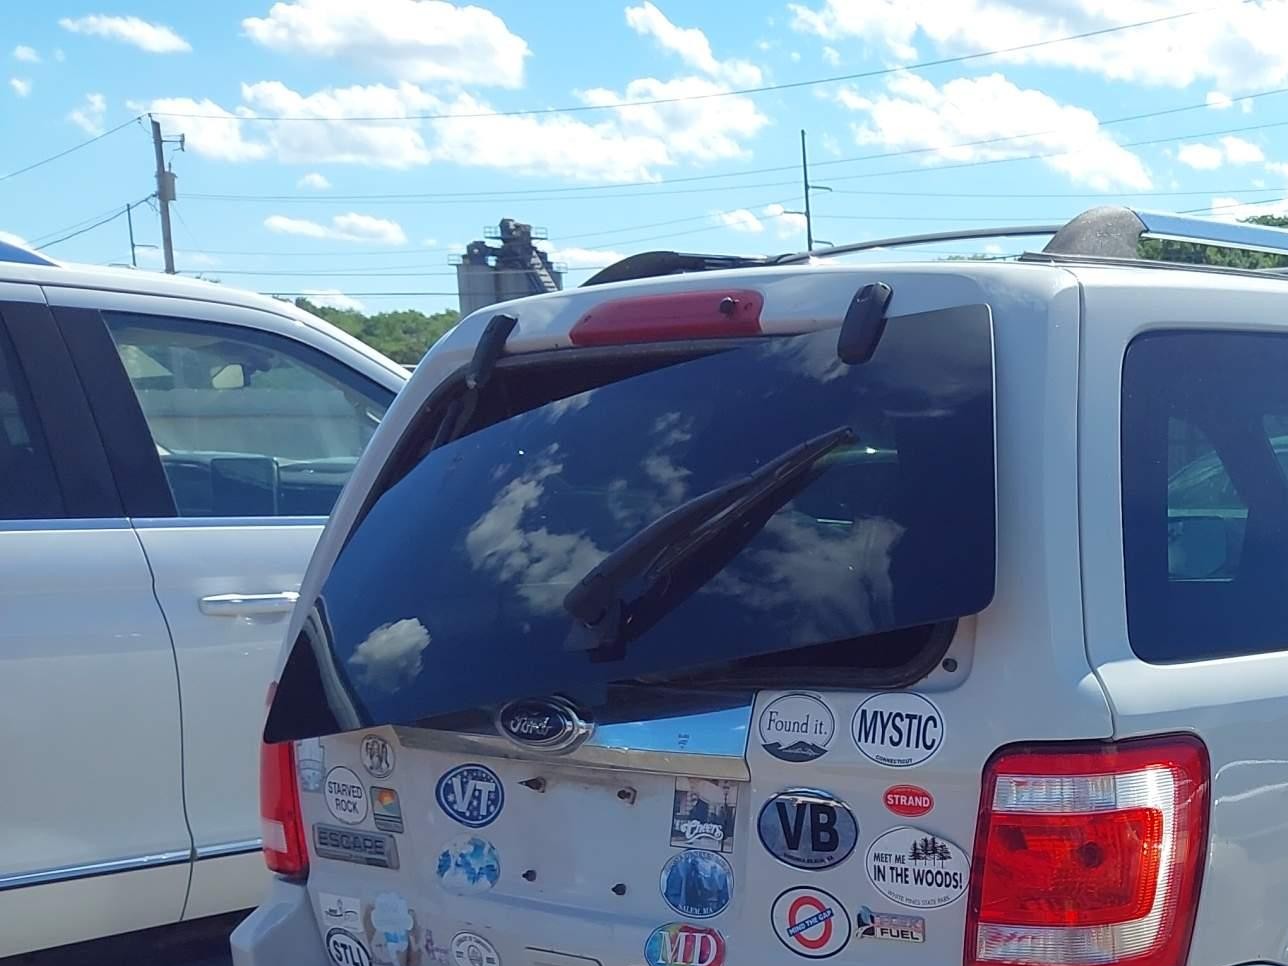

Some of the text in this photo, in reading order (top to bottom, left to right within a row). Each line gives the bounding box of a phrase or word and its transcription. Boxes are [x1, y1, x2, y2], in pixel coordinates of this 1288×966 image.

[510, 716, 551, 736] Ford
[767, 710, 828, 736] Found it.
[857, 708, 938, 751] MYSTIC
[327, 781, 362, 799] STARVED
[452, 775, 496, 816] VT
[886, 794, 931, 808] STRAND
[335, 798, 359, 815] ROCK
[680, 819, 725, 843] Cheers
[775, 801, 840, 852] VB
[317, 827, 385, 855] ESCAPE
[873, 852, 906, 865] MEET ME
[873, 865, 963, 890] IN THE WOODS!
[789, 910, 833, 936] MIND THE GAP
[881, 929, 920, 941] FUEL
[656, 931, 718, 966] MD
